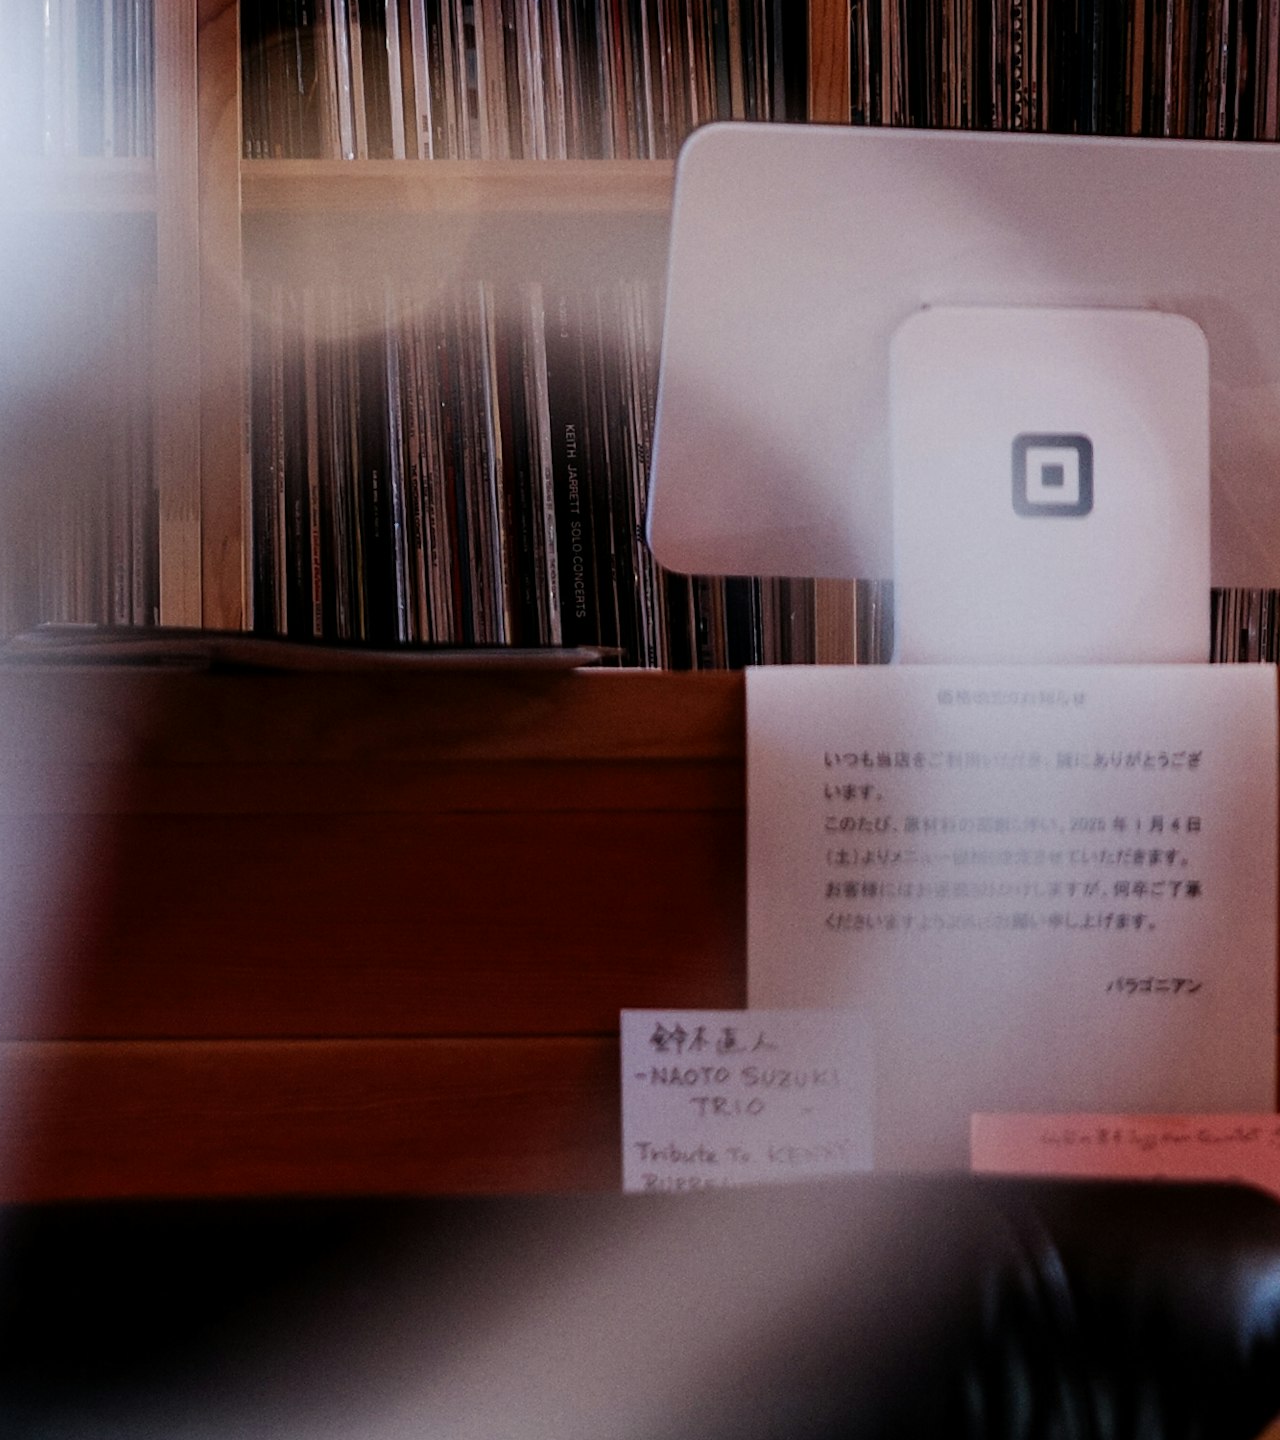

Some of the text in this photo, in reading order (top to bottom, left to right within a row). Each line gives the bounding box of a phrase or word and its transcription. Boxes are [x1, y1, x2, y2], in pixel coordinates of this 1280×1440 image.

[823, 783, 882, 801] います。
[1106, 977, 1202, 994] パラゴニアン
[741, 1065, 840, 1087] SUZUKI
[689, 1096, 766, 1116] TRIO
[635, 1141, 719, 1163] Tribute
